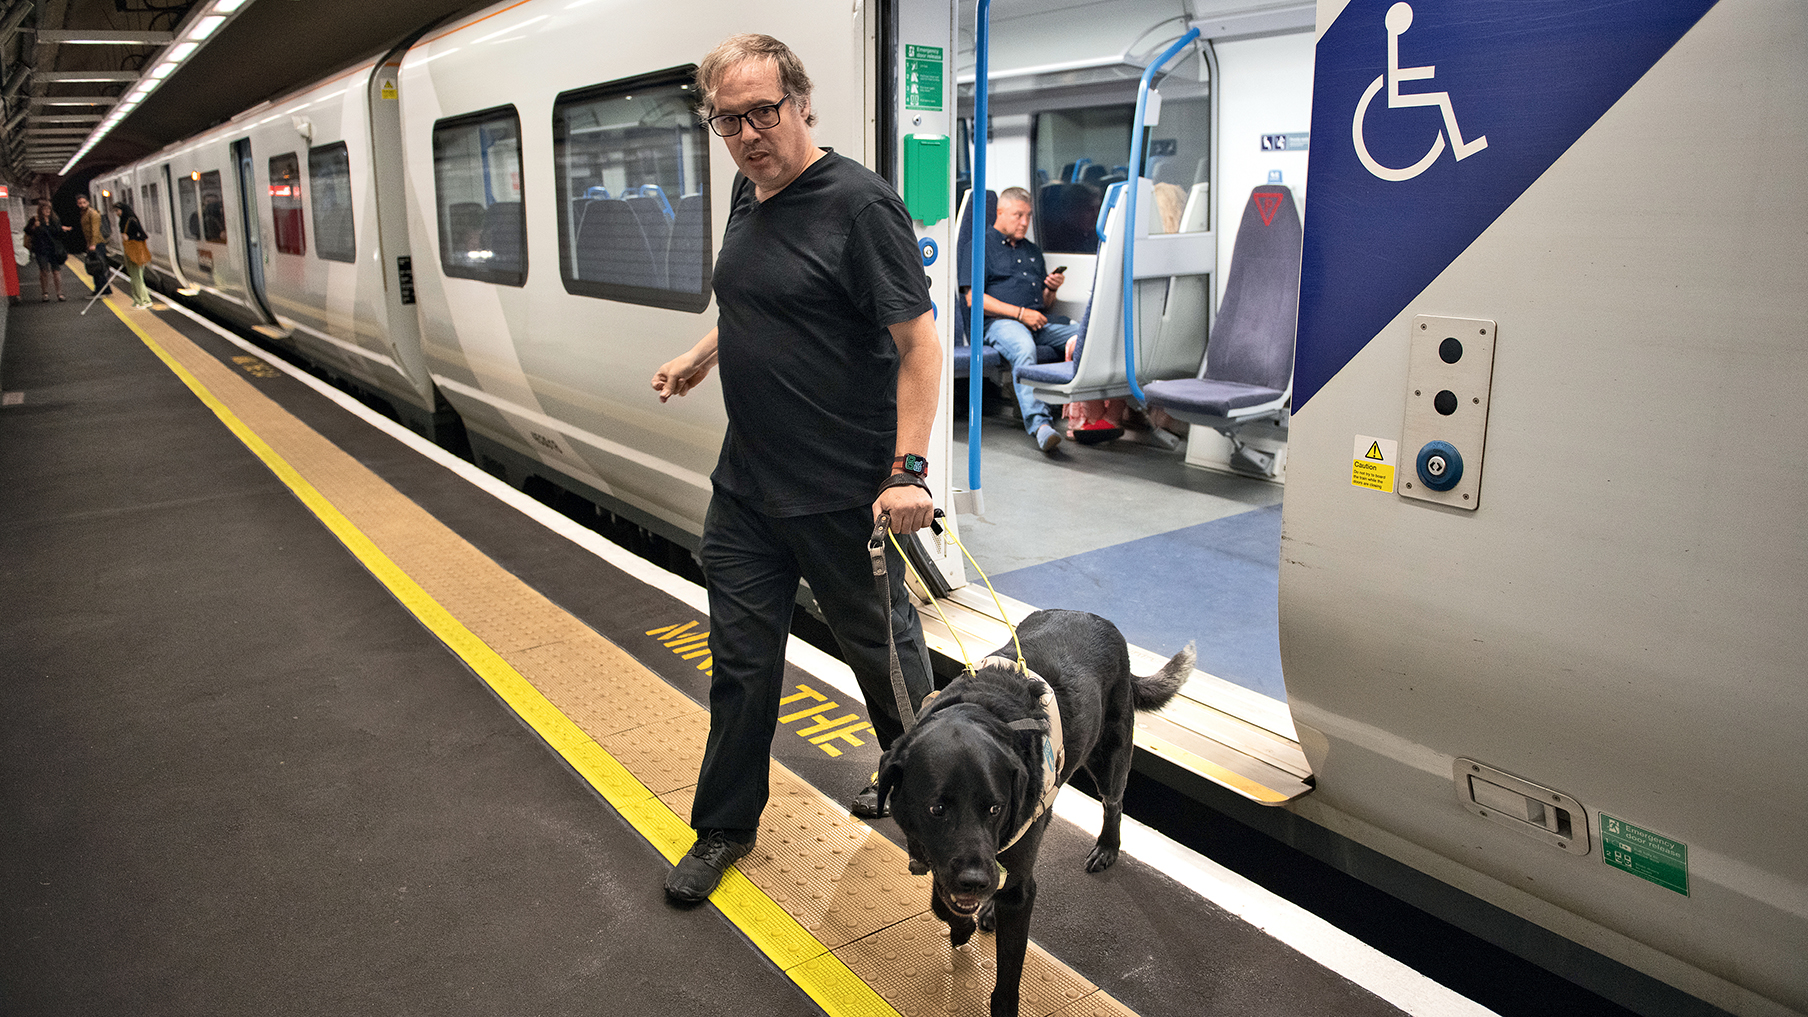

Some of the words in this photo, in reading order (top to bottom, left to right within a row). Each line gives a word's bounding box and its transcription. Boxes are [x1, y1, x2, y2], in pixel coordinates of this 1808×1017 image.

[1354, 461, 1377, 470] Caution
[645, 620, 713, 676] MIN
[777, 684, 878, 758] THE
[1626, 825, 1674, 850] Emergency
[1626, 833, 1646, 844] door
[1648, 842, 1680, 858] release
